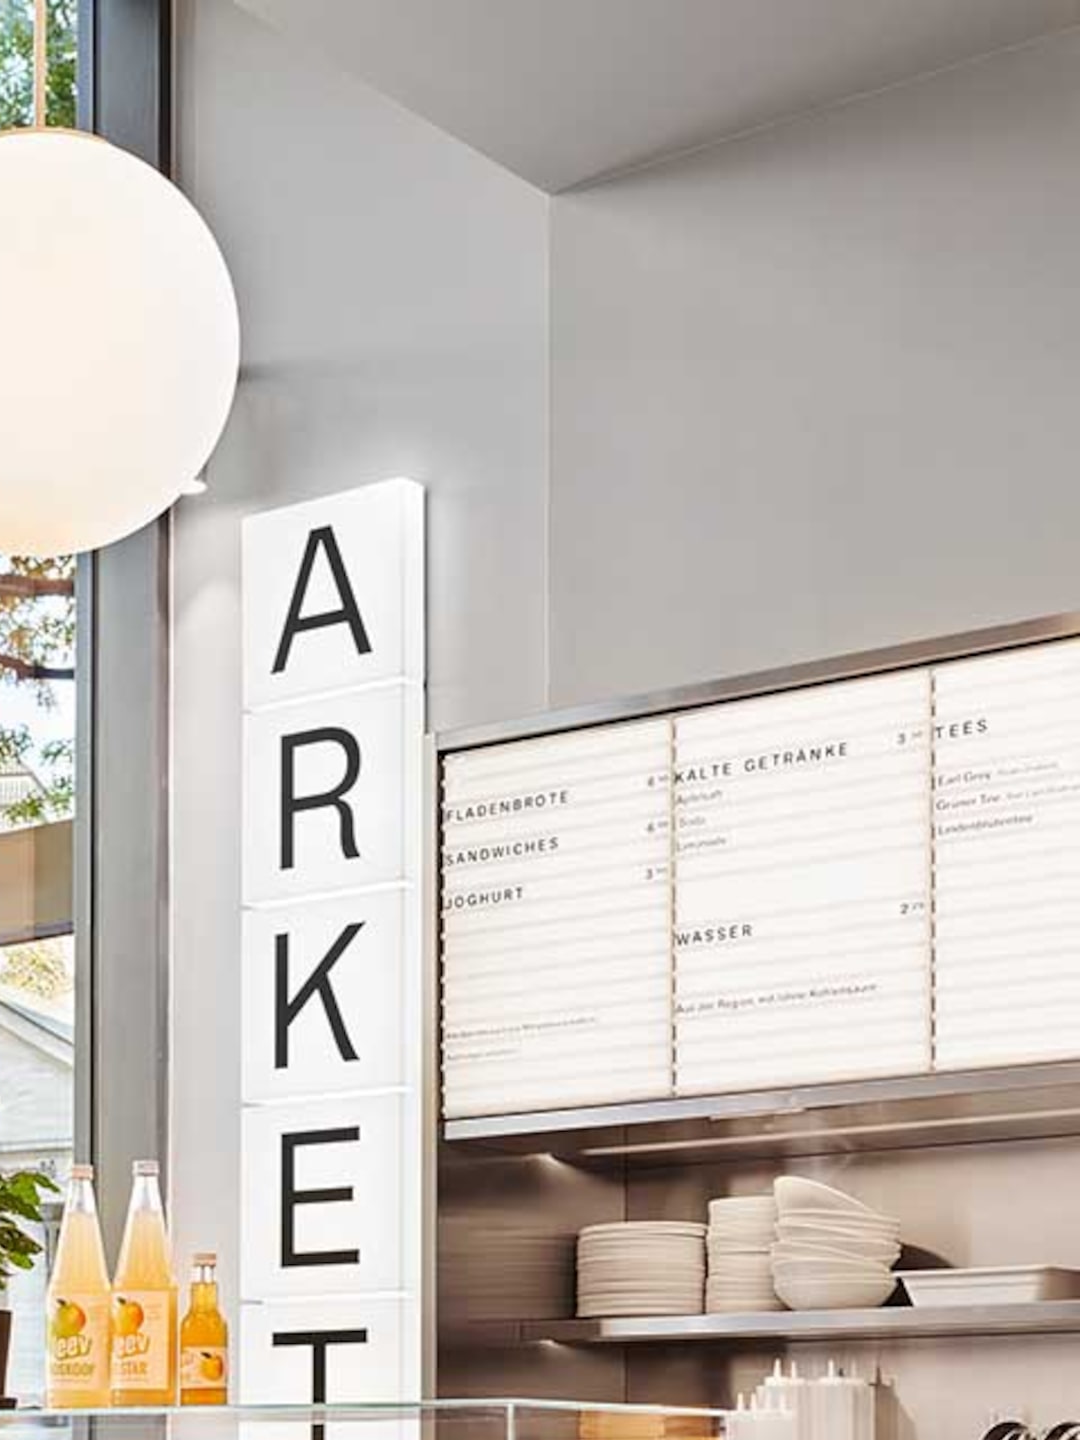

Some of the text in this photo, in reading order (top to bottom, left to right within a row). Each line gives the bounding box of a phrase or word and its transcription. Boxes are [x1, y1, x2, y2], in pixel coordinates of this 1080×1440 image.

[935, 719, 988, 739] TEES
[674, 763, 732, 784] KALTE
[446, 791, 569, 822] FLADENBROTE
[446, 837, 559, 867] SANDWICHES
[444, 887, 524, 911] JOGHURT
[675, 924, 753, 946] WASSER
